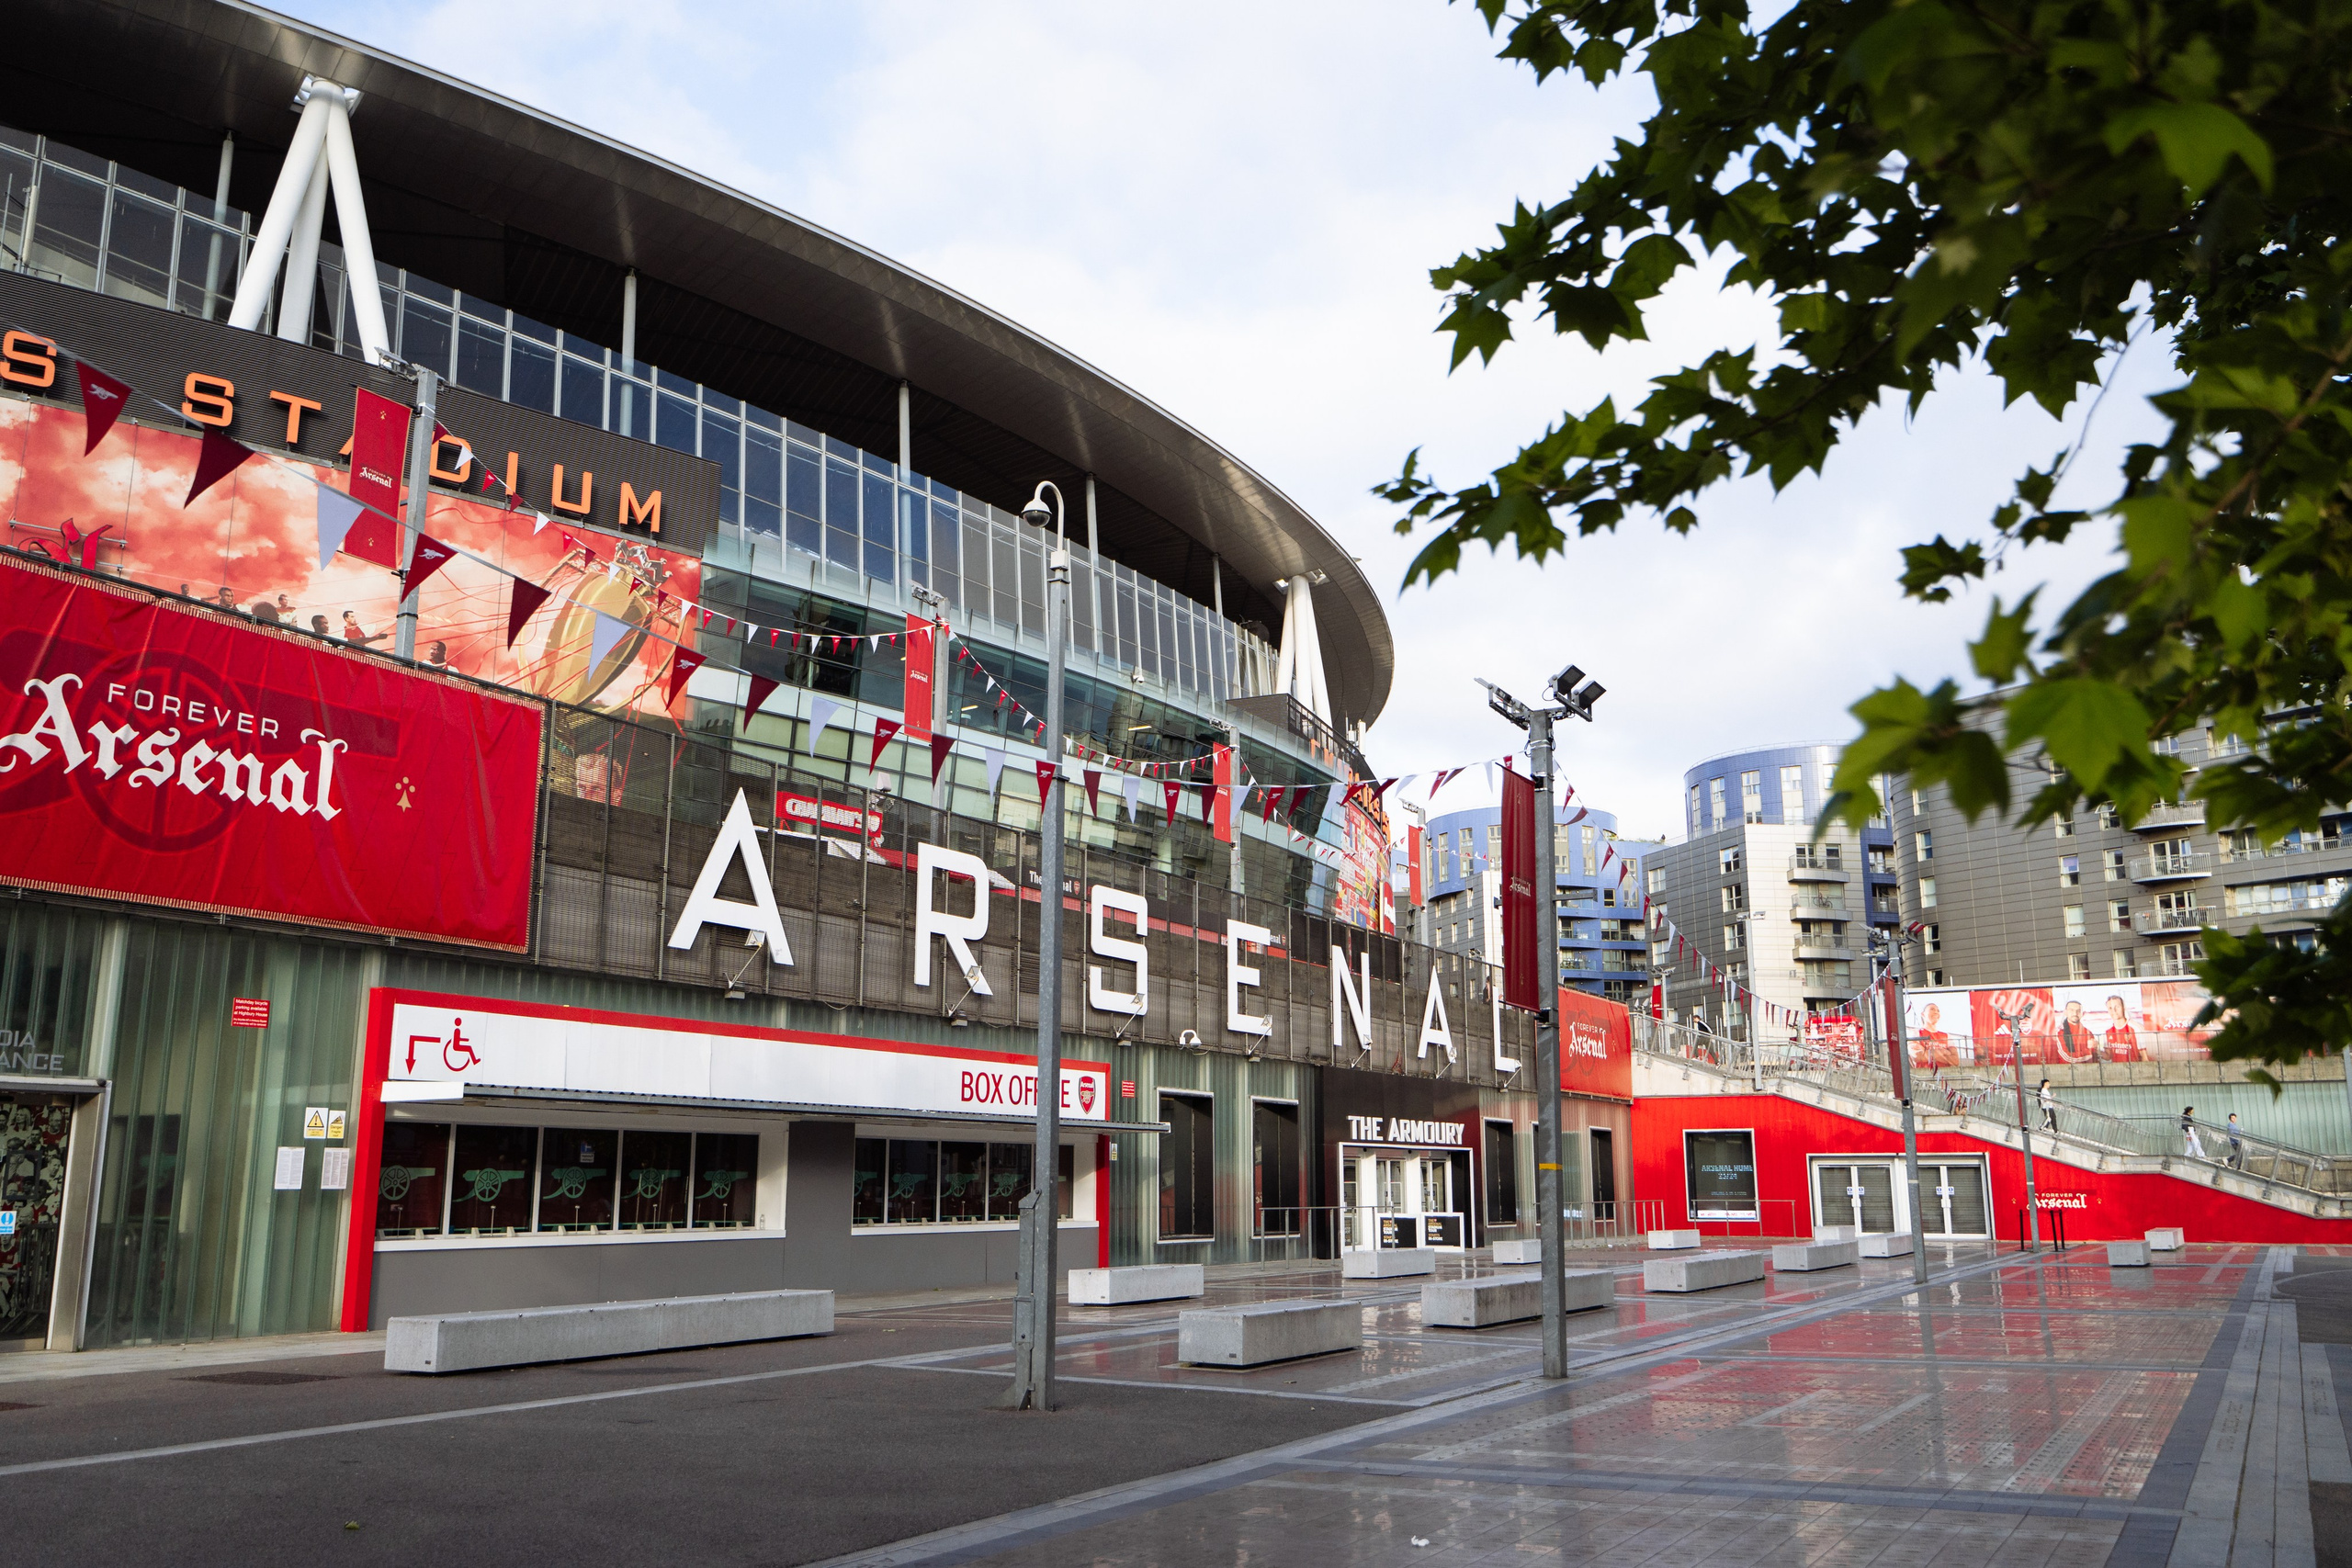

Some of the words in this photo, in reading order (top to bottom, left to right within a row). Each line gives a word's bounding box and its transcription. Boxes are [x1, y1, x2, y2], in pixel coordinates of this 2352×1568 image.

[182, 372, 662, 533] STDIUM
[359, 467, 392, 489] Arsenal
[107, 682, 279, 739] FOREVER
[0, 672, 349, 821] Arsenal
[1029, 870, 1043, 886] The
[668, 787, 1521, 1073] ARSENAL
[1568, 1021, 1608, 1060] Arsenal
[1577, 1022, 1599, 1033] FOREVER
[961, 1071, 1003, 1104] BOX
[1009, 1075, 1071, 1108] OFFE
[1347, 1115, 1384, 1141] THE
[1387, 1117, 1464, 1145] ARMOURY
